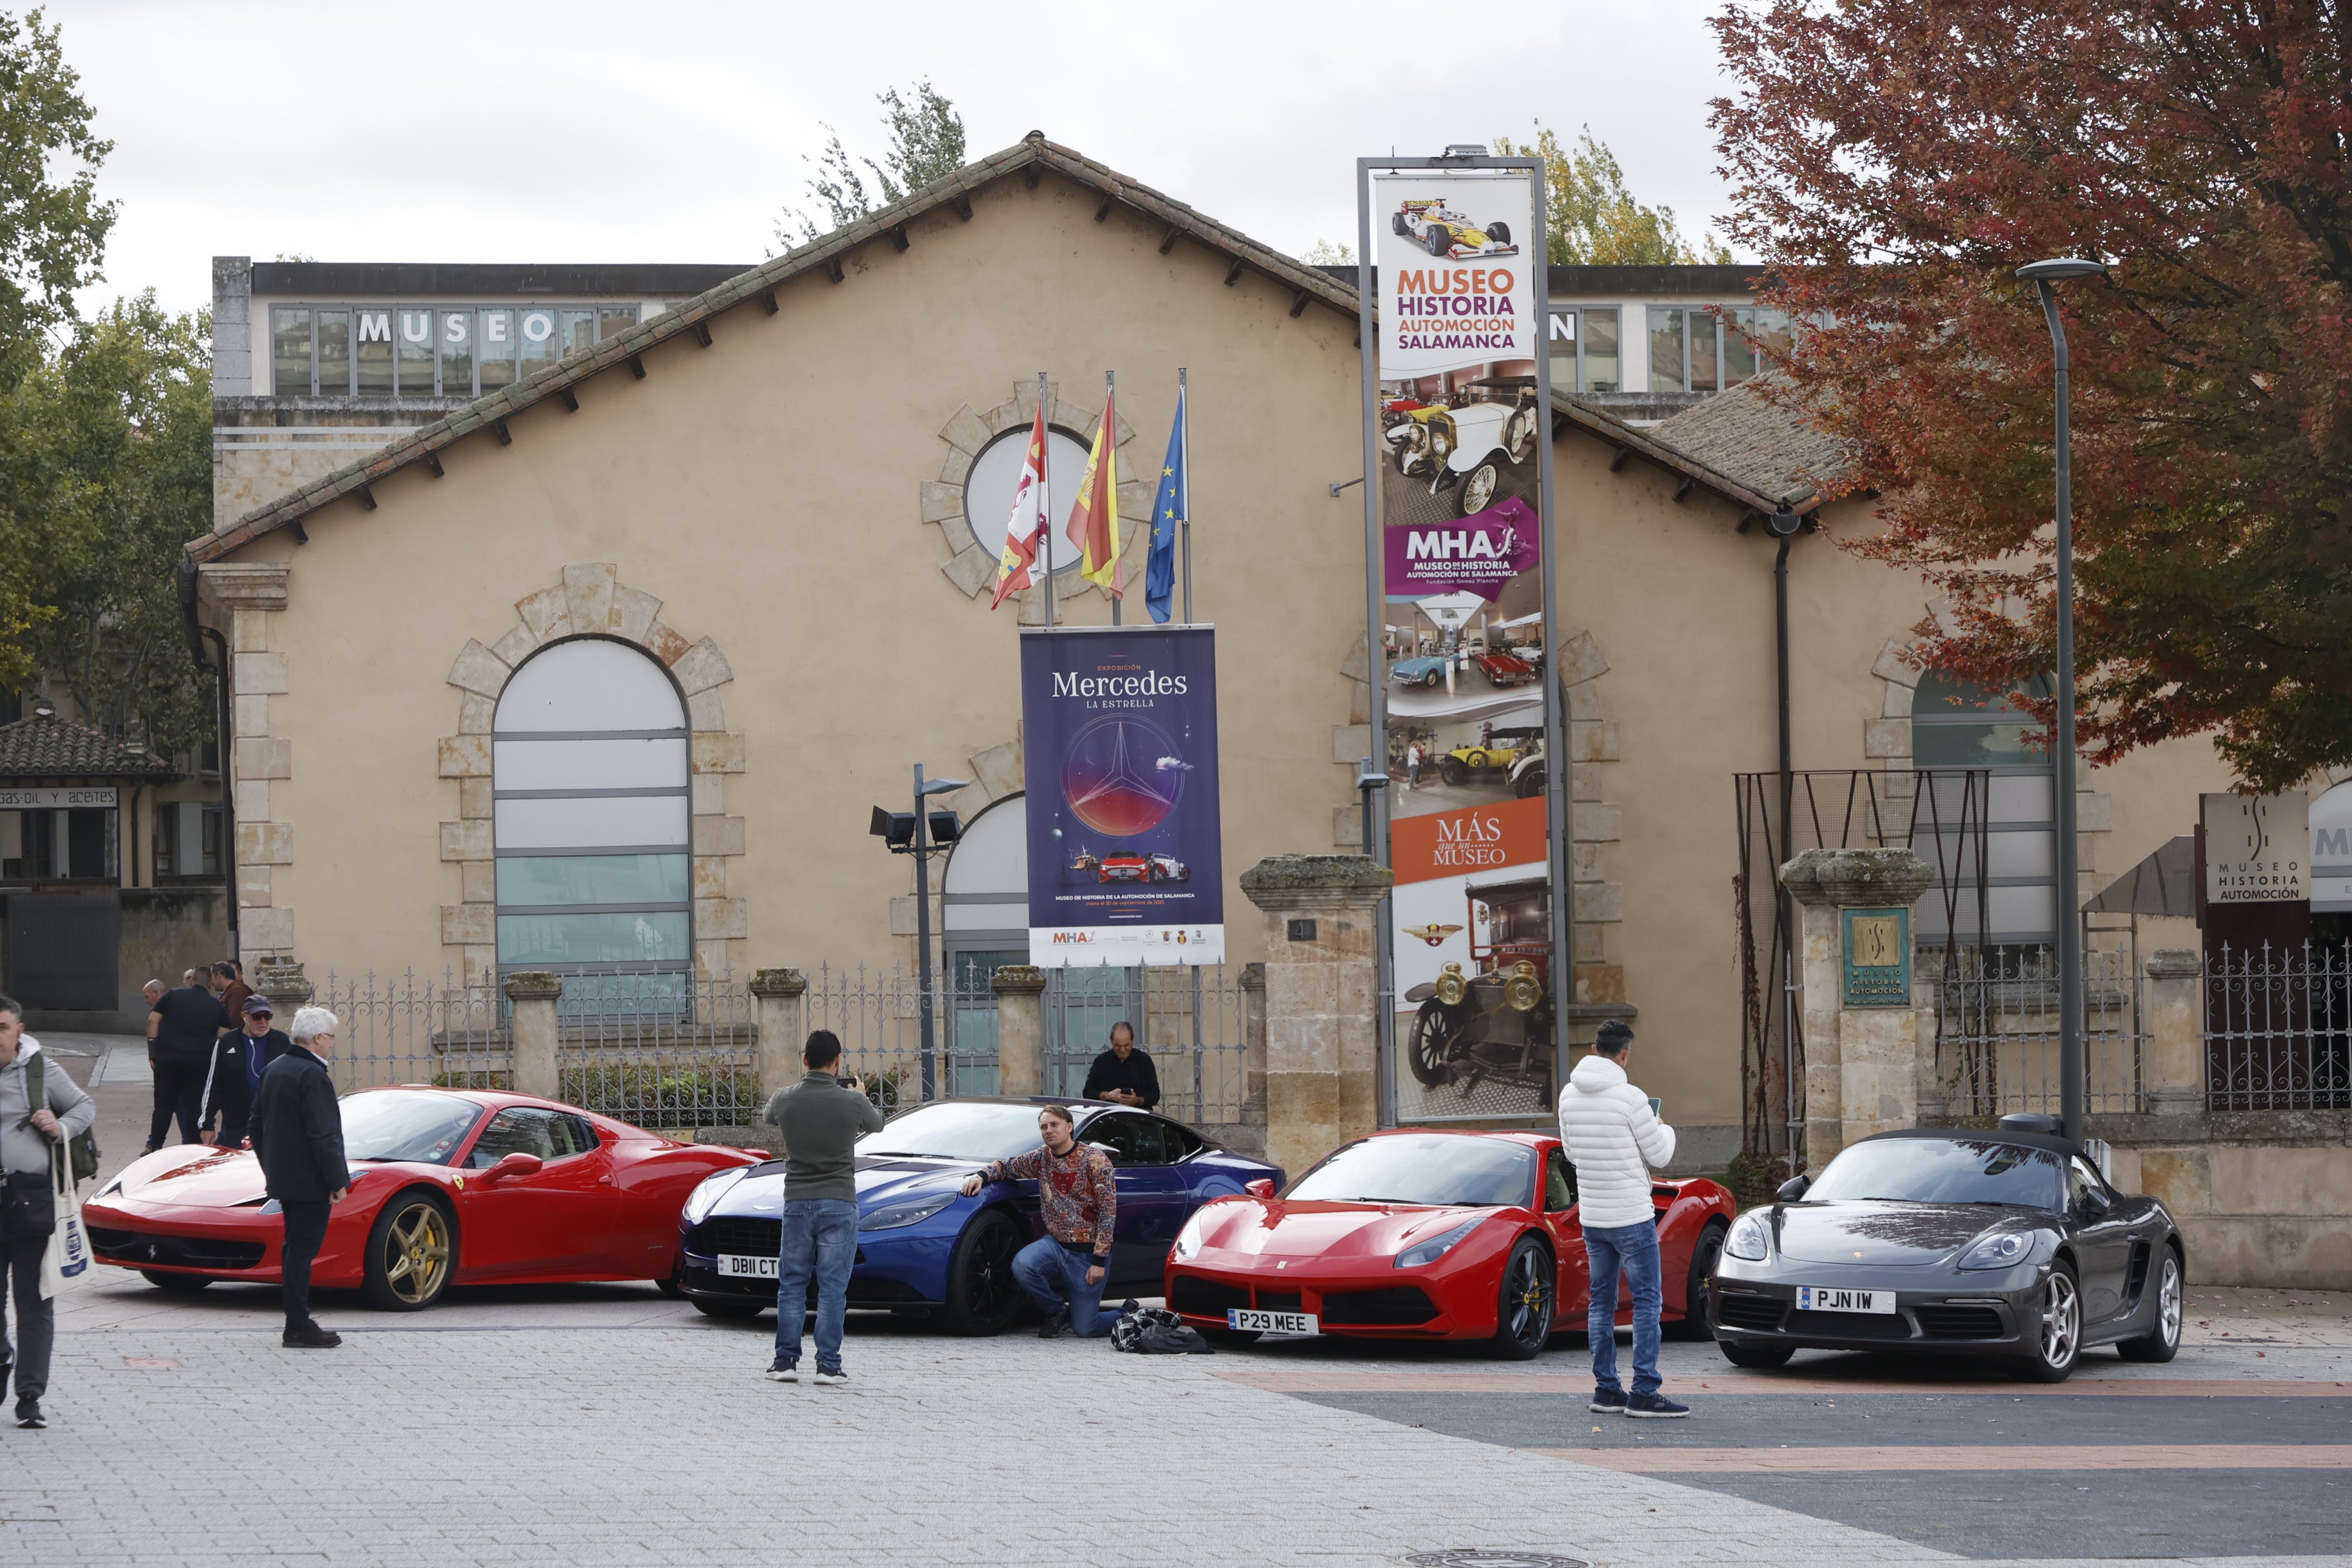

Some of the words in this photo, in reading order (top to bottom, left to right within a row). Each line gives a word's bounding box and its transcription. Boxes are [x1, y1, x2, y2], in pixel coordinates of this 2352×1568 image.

[1397, 268, 1514, 295] MUSEO
[1398, 296, 1515, 316] HISTORIA
[358, 313, 553, 342] MUSEO
[1398, 315, 1515, 333] AUTOMOCIÓN
[1398, 334, 1515, 349] SALAMANCA
[1406, 530, 1496, 560] MHA
[1407, 570, 1459, 578] AUTOMOCIÓN
[1414, 562, 1452, 571] MUSEO
[1462, 561, 1510, 570] HISTORIA
[1052, 669, 1188, 698] Mercedes
[1102, 699, 1155, 709] ESTRELLA
[52, 792, 59, 803] Y
[1436, 811, 1502, 842] MÁS
[1438, 843, 1456, 854] que
[2315, 828, 2352, 856] M
[1433, 848, 1506, 865] MUSEO
[2219, 861, 2298, 873] MUSEO
[2219, 876, 2298, 887] HISTORIA
[2220, 887, 2299, 900] AUTOMOCIÓN
[1053, 932, 1088, 943] MHA
[1294, 921, 1306, 939] 4
[1850, 985, 1904, 994] AUTOMOCIÓN
[760, 1259, 781, 1275] CT
[1239, 1312, 1271, 1329] P29
[1275, 1315, 1306, 1331] MEE
